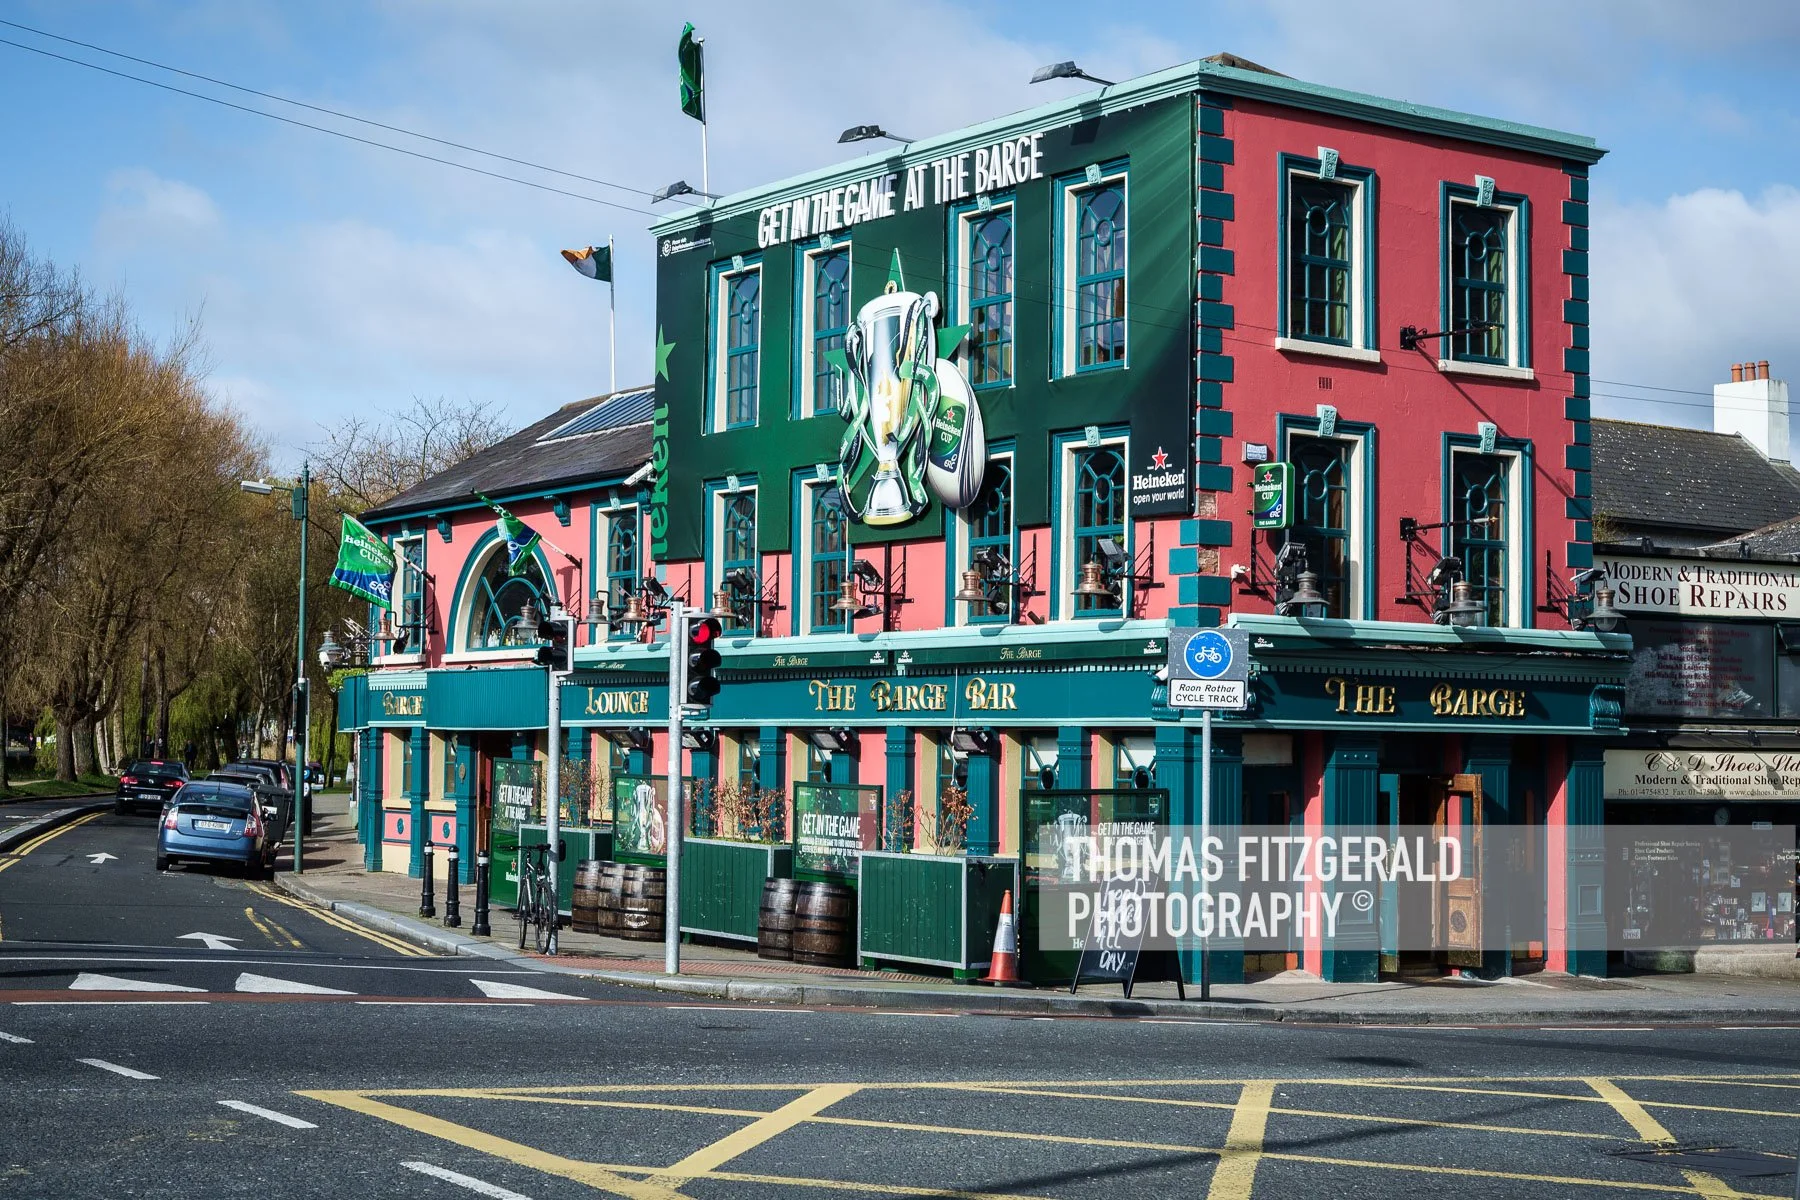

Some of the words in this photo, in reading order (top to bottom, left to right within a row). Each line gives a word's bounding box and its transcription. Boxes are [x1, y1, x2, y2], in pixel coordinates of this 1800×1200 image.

[758, 202, 792, 249] GET
[791, 197, 810, 239] IN
[812, 188, 844, 234] THE
[844, 174, 897, 226] GAME
[904, 164, 928, 211] AT
[931, 153, 969, 204] THE
[975, 132, 1043, 194] BARGE
[936, 418, 962, 437] Heineken
[941, 431, 952, 443] CUP
[1133, 469, 1186, 490] Heineken
[1255, 482, 1282, 492] Heineken
[1133, 493, 1150, 504] open
[1152, 491, 1166, 503] your
[1167, 488, 1185, 500] world
[1261, 491, 1274, 500] CUP
[344, 535, 394, 568] Heineken
[360, 548, 381, 566] CUP
[1016, 646, 1042, 659] BARGE
[808, 678, 856, 711] THE
[870, 680, 947, 712] BARGE
[965, 677, 1018, 710] BAR
[1179, 683, 1201, 692] Raon
[1204, 684, 1236, 693] Rothar
[1325, 676, 1396, 714] THE
[1429, 682, 1526, 717] BARGE
[382, 690, 424, 715] BARGE
[585, 687, 649, 714] LOUNGE
[1175, 694, 1204, 703] CYCLE
[1208, 694, 1239, 703] TRACK
[1645, 753, 1662, 771] C
[1667, 756, 1682, 772] &
[1688, 753, 1705, 771] D
[1711, 753, 1762, 772] Shoes
[1772, 754, 1800, 772] Ltd
[1635, 774, 1677, 785] Modern
[1681, 775, 1690, 785] &
[1693, 774, 1751, 785] Traditional
[1754, 775, 1779, 785] Shoe
[1618, 788, 1629, 796] Ph:
[1672, 788, 1687, 796] Fax:
[802, 812, 816, 834] GET
[816, 813, 824, 835] IN
[825, 815, 839, 836] THE
[839, 815, 861, 838] GAME
[1098, 822, 1112, 836] GET
[1112, 822, 1120, 835] IN
[1121, 822, 1134, 835] THE
[1134, 821, 1155, 834] GAME
[1100, 950, 1126, 973] DAY
